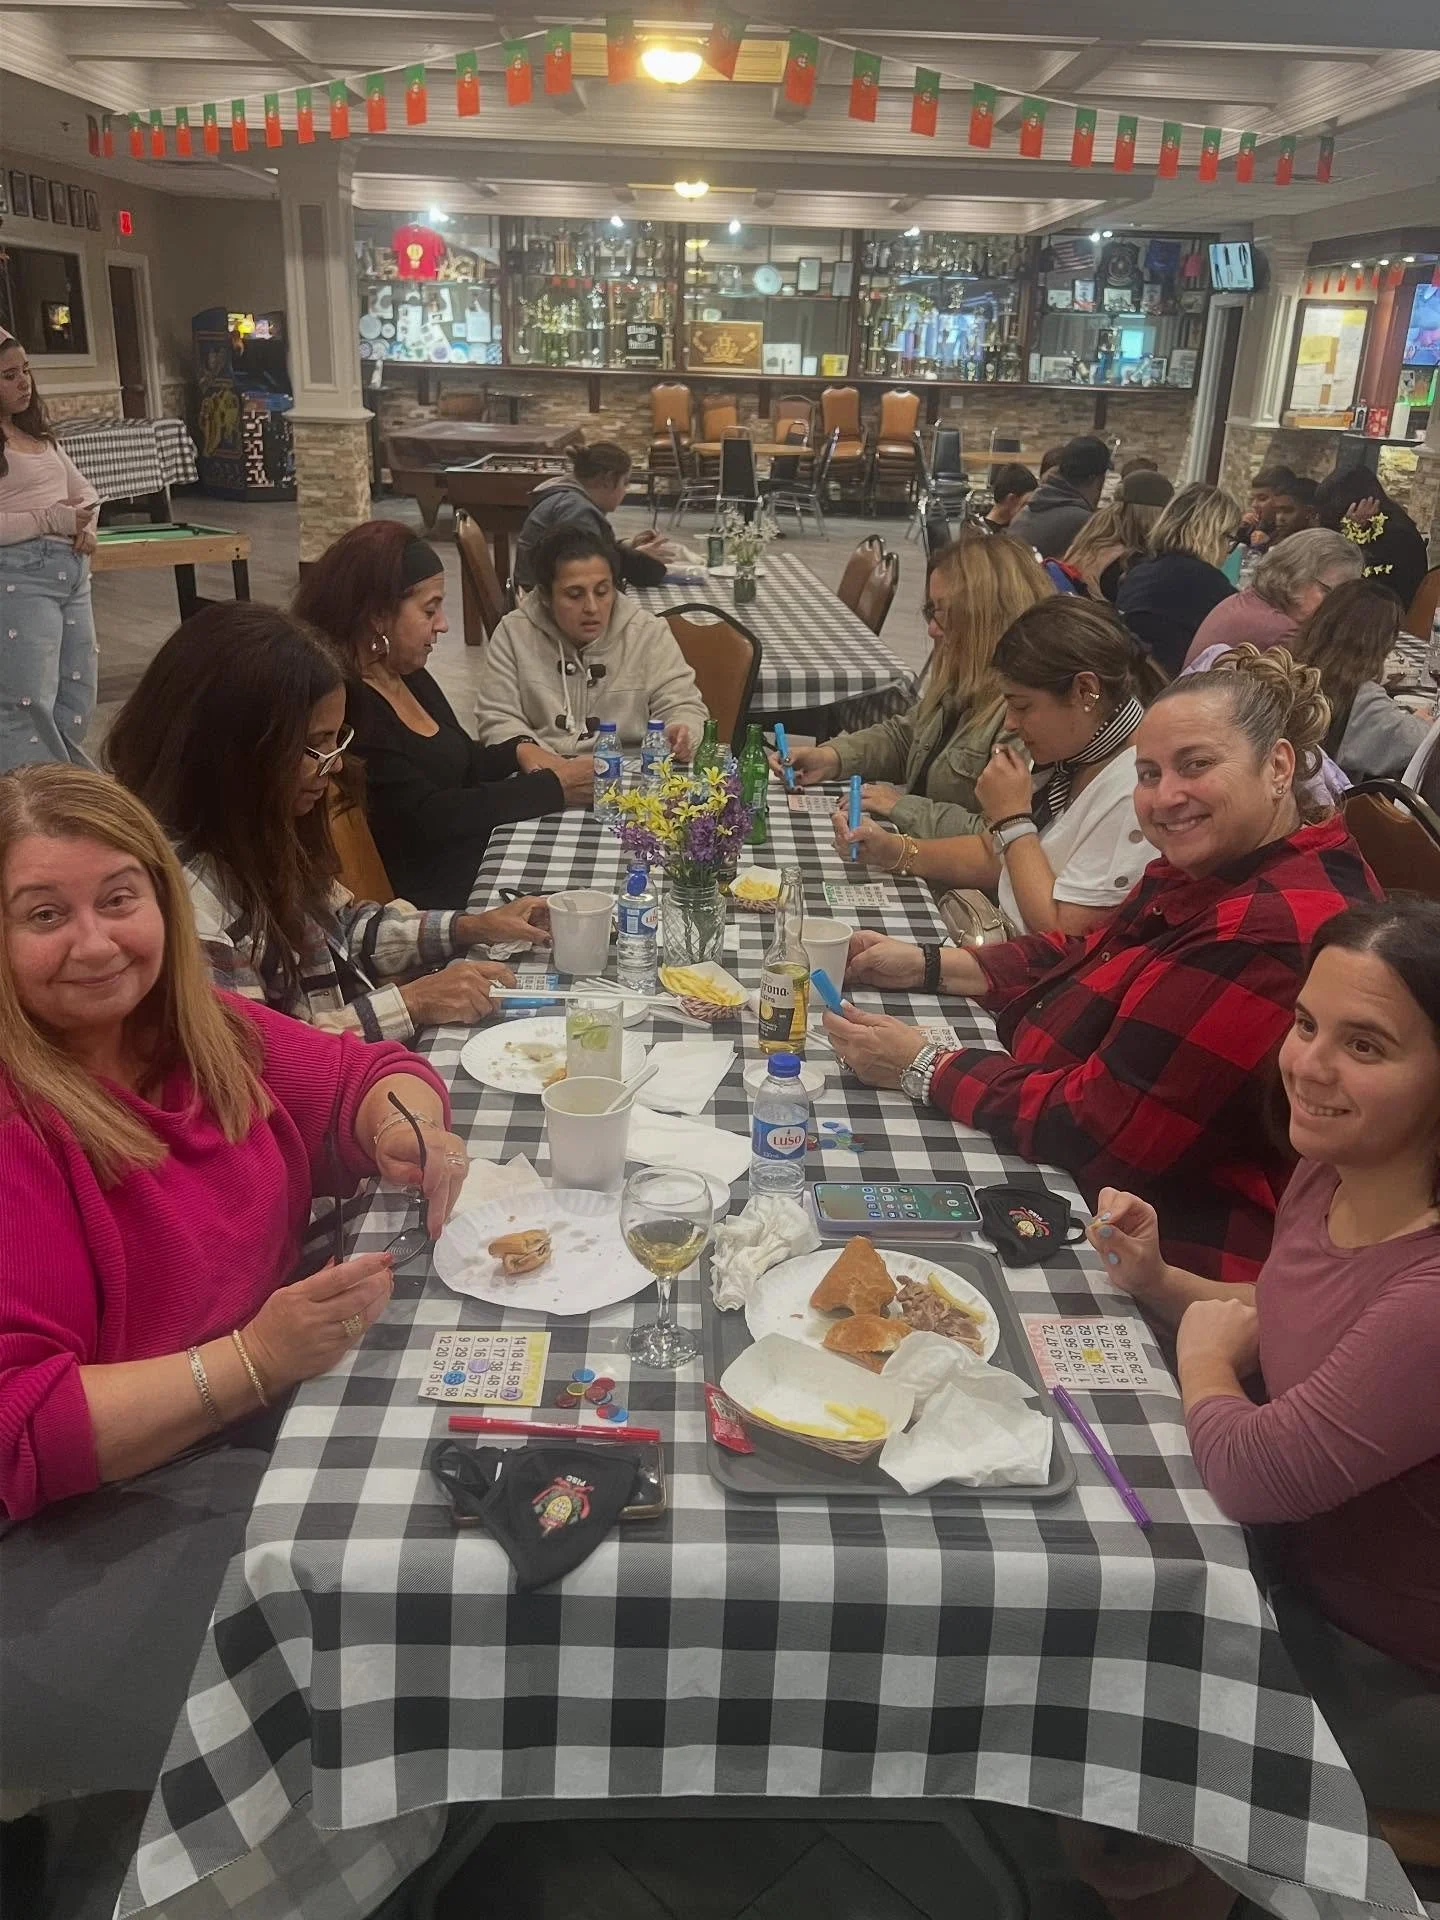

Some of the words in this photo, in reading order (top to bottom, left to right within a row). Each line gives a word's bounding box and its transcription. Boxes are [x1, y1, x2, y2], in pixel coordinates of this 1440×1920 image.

[773, 1135, 801, 1146] LUSO
[1042, 1325, 1055, 1334] 72
[1060, 1326, 1073, 1335] 63
[1079, 1325, 1092, 1335] 62
[1096, 1325, 1110, 1335] 73
[1115, 1325, 1128, 1336] 68
[440, 1336, 452, 1344] 12
[514, 1336, 527, 1345] 14
[1046, 1338, 1059, 1346] 47
[1064, 1338, 1077, 1348] 56
[1082, 1338, 1095, 1348] 49
[1101, 1338, 1114, 1348] 57
[1119, 1339, 1132, 1349] 46
[436, 1347, 449, 1357] 20
[456, 1347, 468, 1357] 29
[474, 1348, 486, 1357] 16
[494, 1349, 505, 1358] 17
[512, 1349, 524, 1358] 18
[1051, 1350, 1063, 1359] 43
[1071, 1350, 1082, 1361] 37
[1107, 1351, 1119, 1361] 41
[1126, 1352, 1138, 1361] 38
[433, 1361, 446, 1370] 37
[452, 1361, 465, 1371] 45
[491, 1361, 503, 1372] 38
[510, 1362, 523, 1371] 44
[1056, 1363, 1069, 1371] 20
[1073, 1364, 1085, 1372] 19
[1094, 1365, 1106, 1373] 24
[1113, 1365, 1125, 1373] 21
[1130, 1364, 1143, 1374] 29
[430, 1374, 442, 1383] 51
[469, 1375, 481, 1385] 57
[487, 1375, 500, 1386] 48
[507, 1375, 520, 1386] 58
[1135, 1377, 1148, 1385] 12
[426, 1387, 439, 1396] 64
[445, 1388, 458, 1397] 68
[465, 1388, 478, 1398] 72
[484, 1388, 498, 1398] 75
